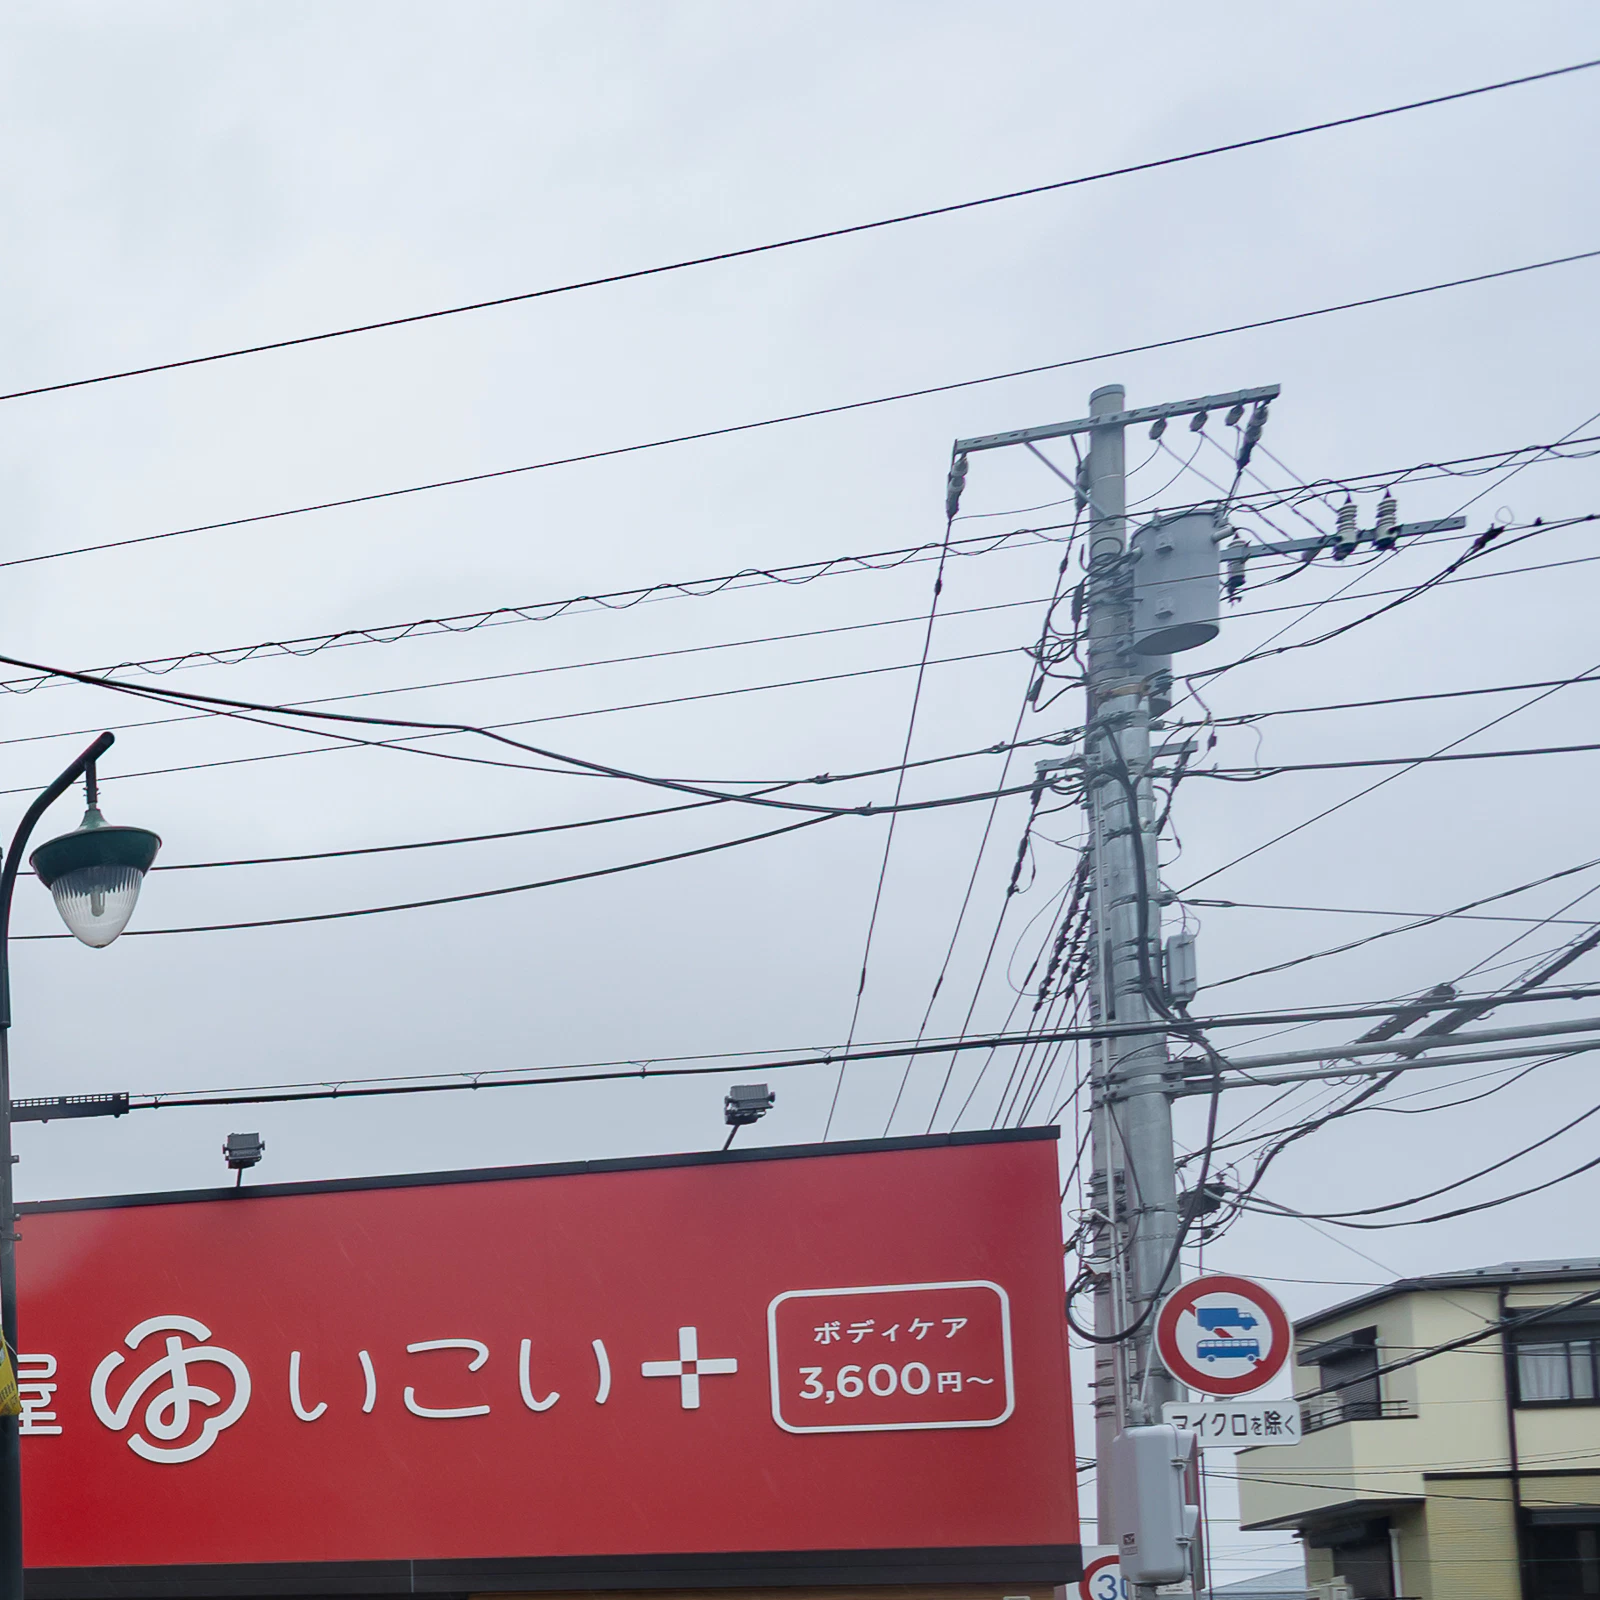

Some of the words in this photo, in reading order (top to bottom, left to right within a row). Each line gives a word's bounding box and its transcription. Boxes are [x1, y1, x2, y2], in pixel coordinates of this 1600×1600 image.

[813, 1315, 970, 1346] ボディケア
[1171, 1410, 1295, 1437] マイクロを除く
